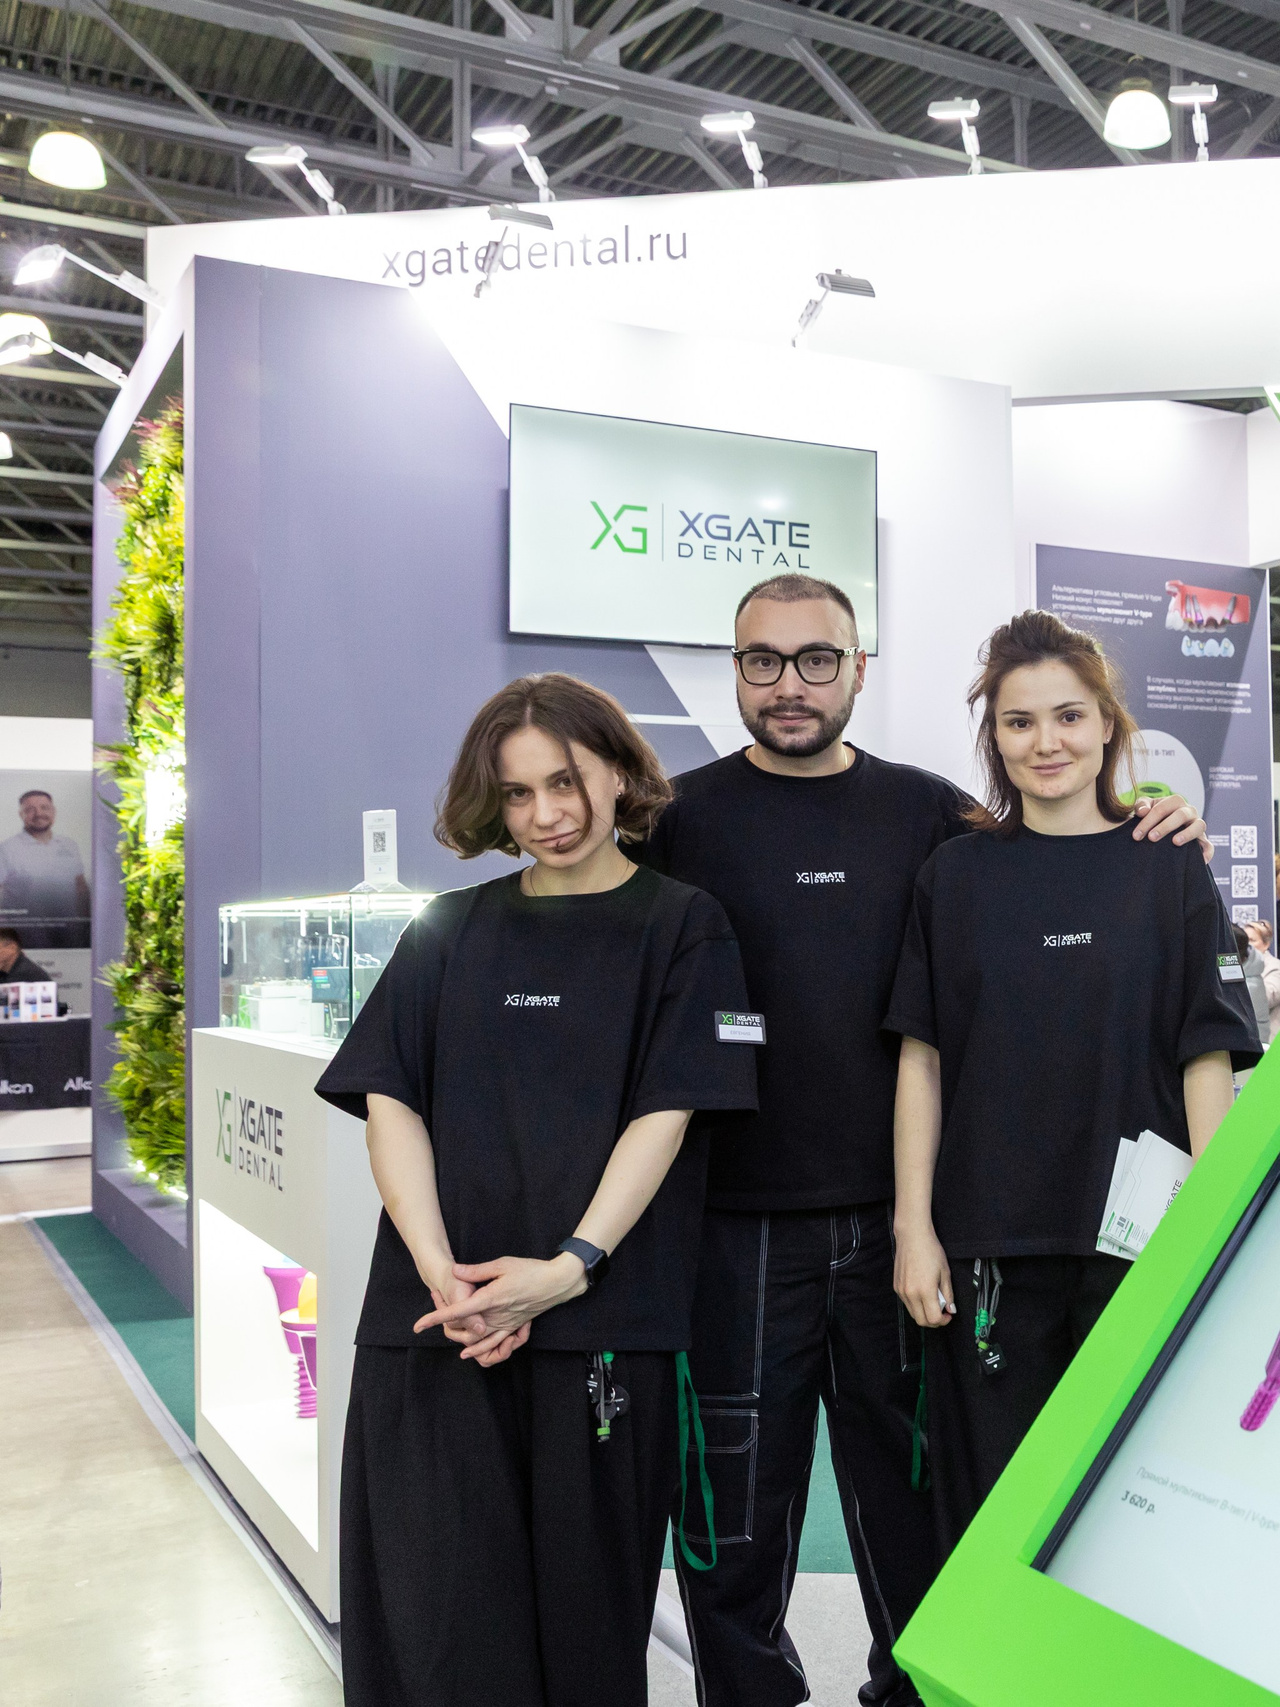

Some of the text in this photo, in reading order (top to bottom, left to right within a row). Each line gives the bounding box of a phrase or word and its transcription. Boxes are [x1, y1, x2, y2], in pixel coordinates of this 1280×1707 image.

[382, 225, 687, 287] xgatedental.ru
[678, 510, 810, 549] XGATE
[677, 543, 810, 569] DENTAL
[814, 871, 845, 879] XGATE
[1062, 933, 1092, 941] XGATE
[525, 995, 560, 1003] XGATE
[736, 1014, 760, 1023] XGATE
[239, 1096, 284, 1157] XGATE
[238, 1146, 285, 1192] DENTAL
[1121, 1490, 1131, 1502] 3
[1130, 1494, 1148, 1511] 620
